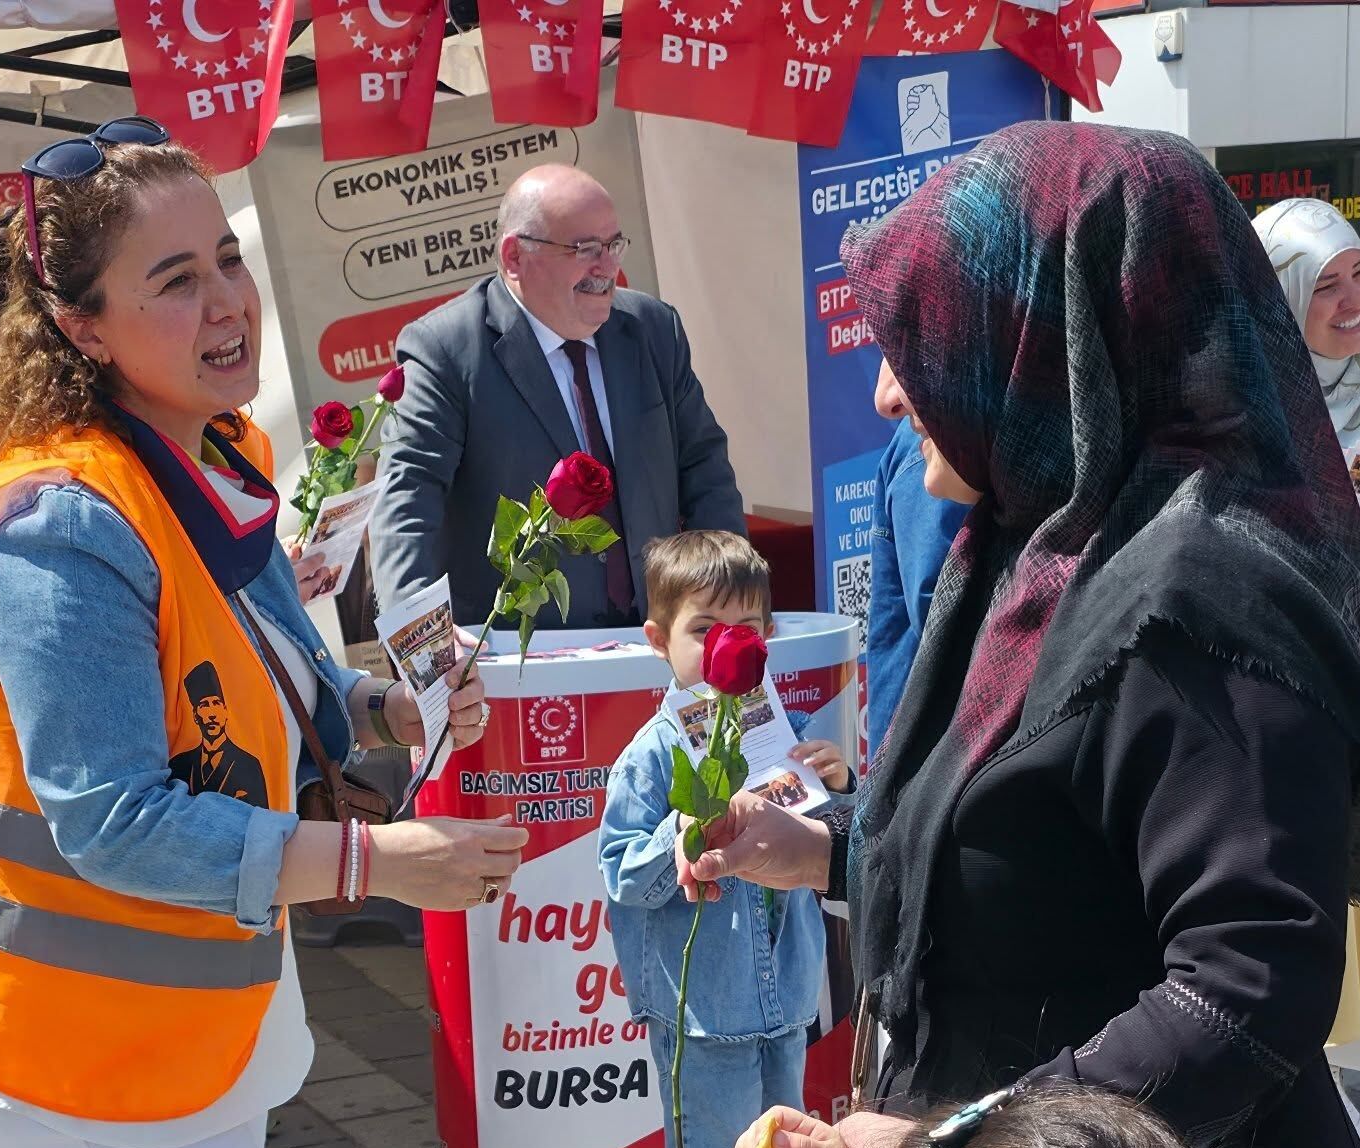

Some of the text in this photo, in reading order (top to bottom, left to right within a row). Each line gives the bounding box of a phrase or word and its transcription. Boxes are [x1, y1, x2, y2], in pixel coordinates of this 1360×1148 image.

[661, 34, 728, 71] BTP
[783, 59, 832, 93] BTP
[187, 78, 266, 121] BTP
[333, 129, 560, 200] EKONOMİK SİSTEM
[359, 239, 417, 270] YENİ
[423, 228, 464, 259] BİR
[424, 245, 499, 277] LAZIM
[820, 285, 852, 314] BTP
[839, 535, 851, 552] VE
[540, 745, 567, 757] BTP
[460, 770, 559, 796] BAĞIMSIZ
[516, 797, 594, 823] PARTİSİ
[502, 1017, 614, 1051] bizimle
[494, 1059, 648, 1110] BURSA
